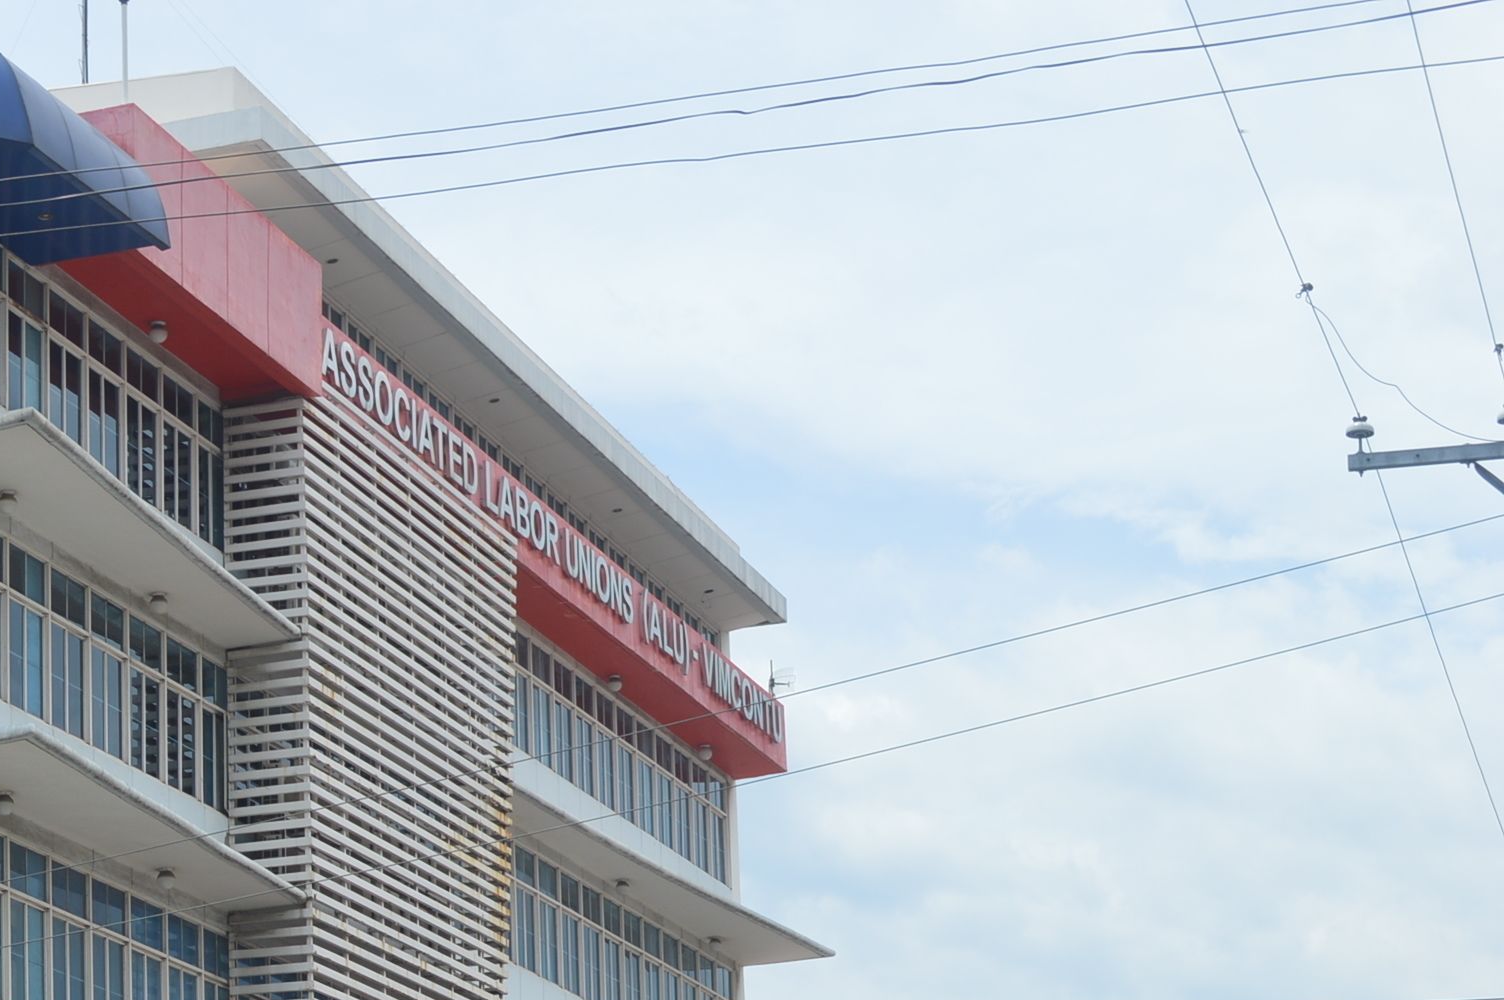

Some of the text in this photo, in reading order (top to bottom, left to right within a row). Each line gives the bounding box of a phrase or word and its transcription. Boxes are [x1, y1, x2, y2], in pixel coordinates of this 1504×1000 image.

[321, 327, 479, 498] ASSOCIATED
[485, 458, 562, 566] LABOR
[564, 527, 634, 625] UNIONS
[701, 639, 783, 746] VIMCONTU
